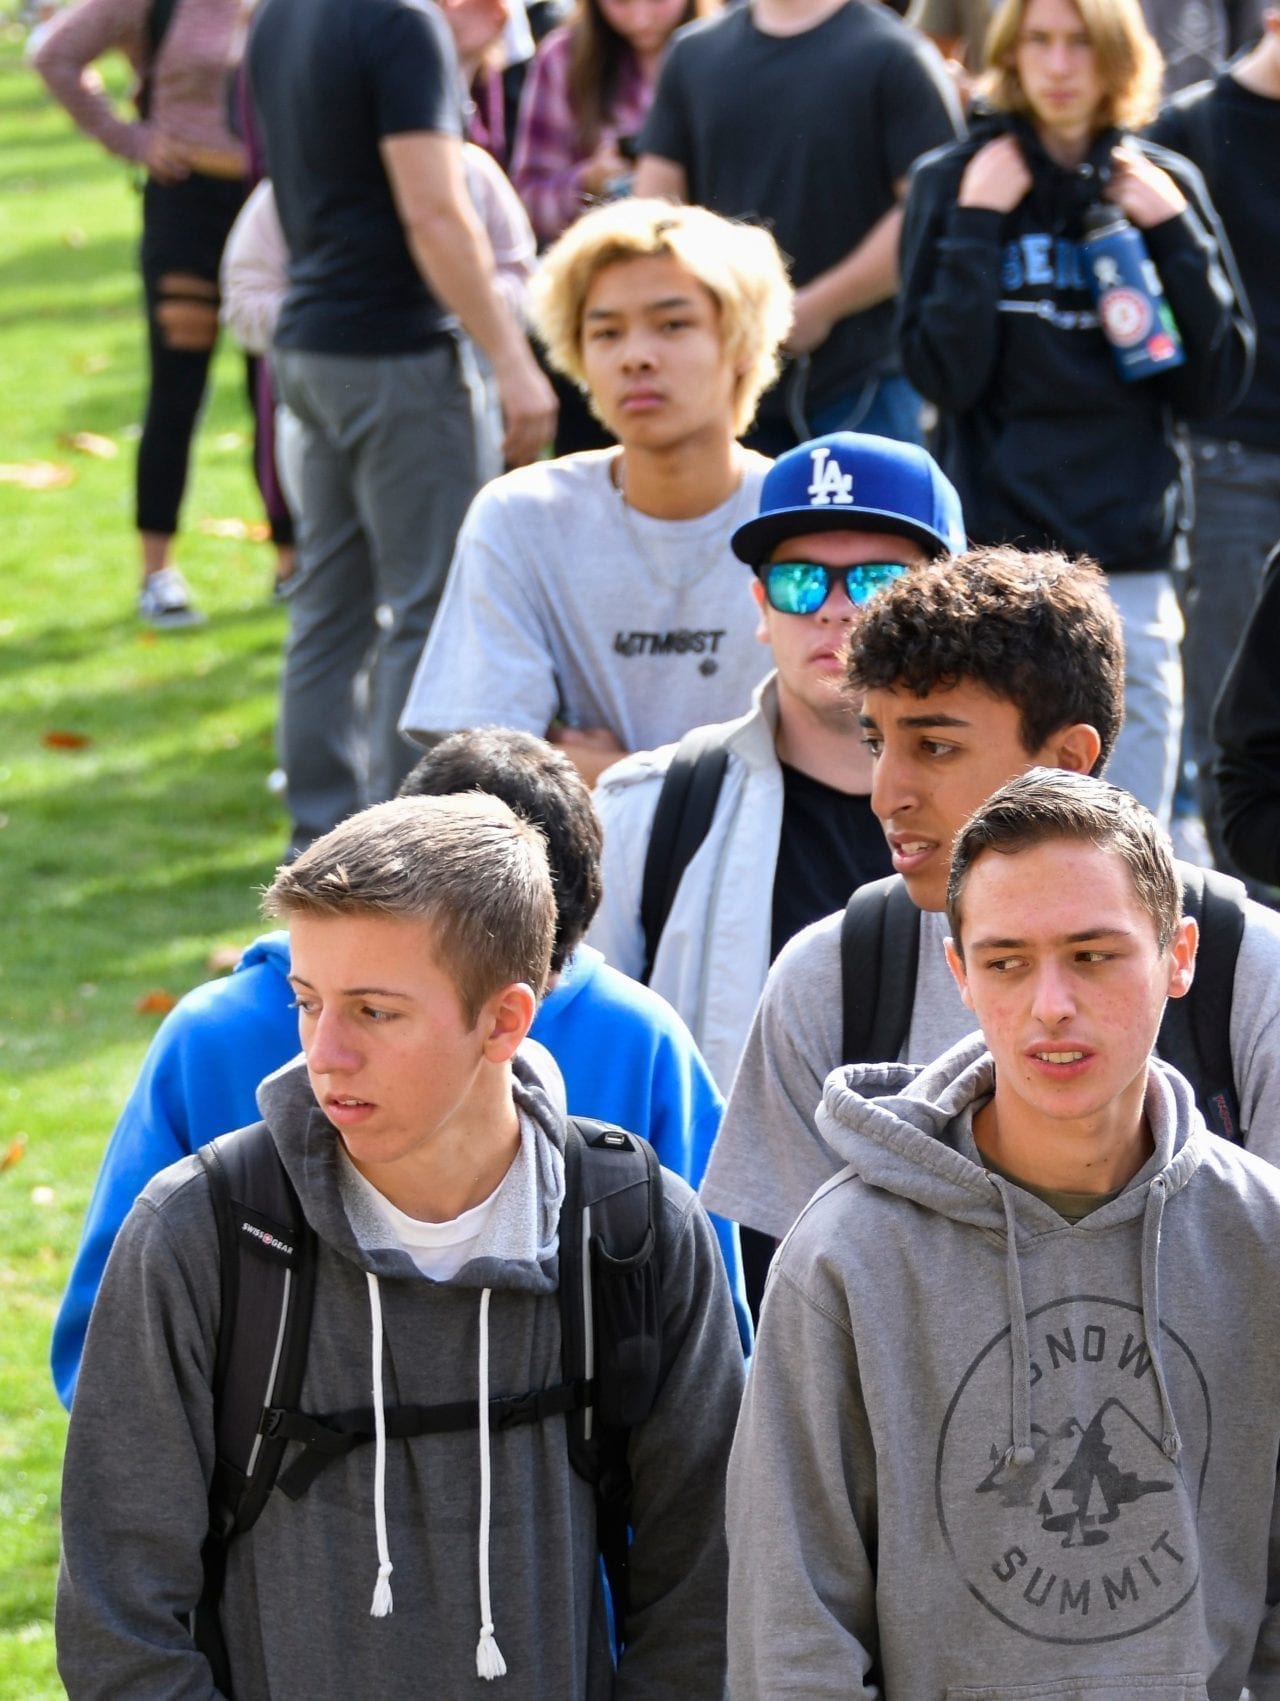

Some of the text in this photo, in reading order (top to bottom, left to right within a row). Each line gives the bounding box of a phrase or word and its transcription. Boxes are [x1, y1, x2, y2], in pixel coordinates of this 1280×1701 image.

[807, 447, 854, 505] LA
[241, 1222, 294, 1255] SWISS GEAR
[992, 1529, 1184, 1616] SUMMIT
